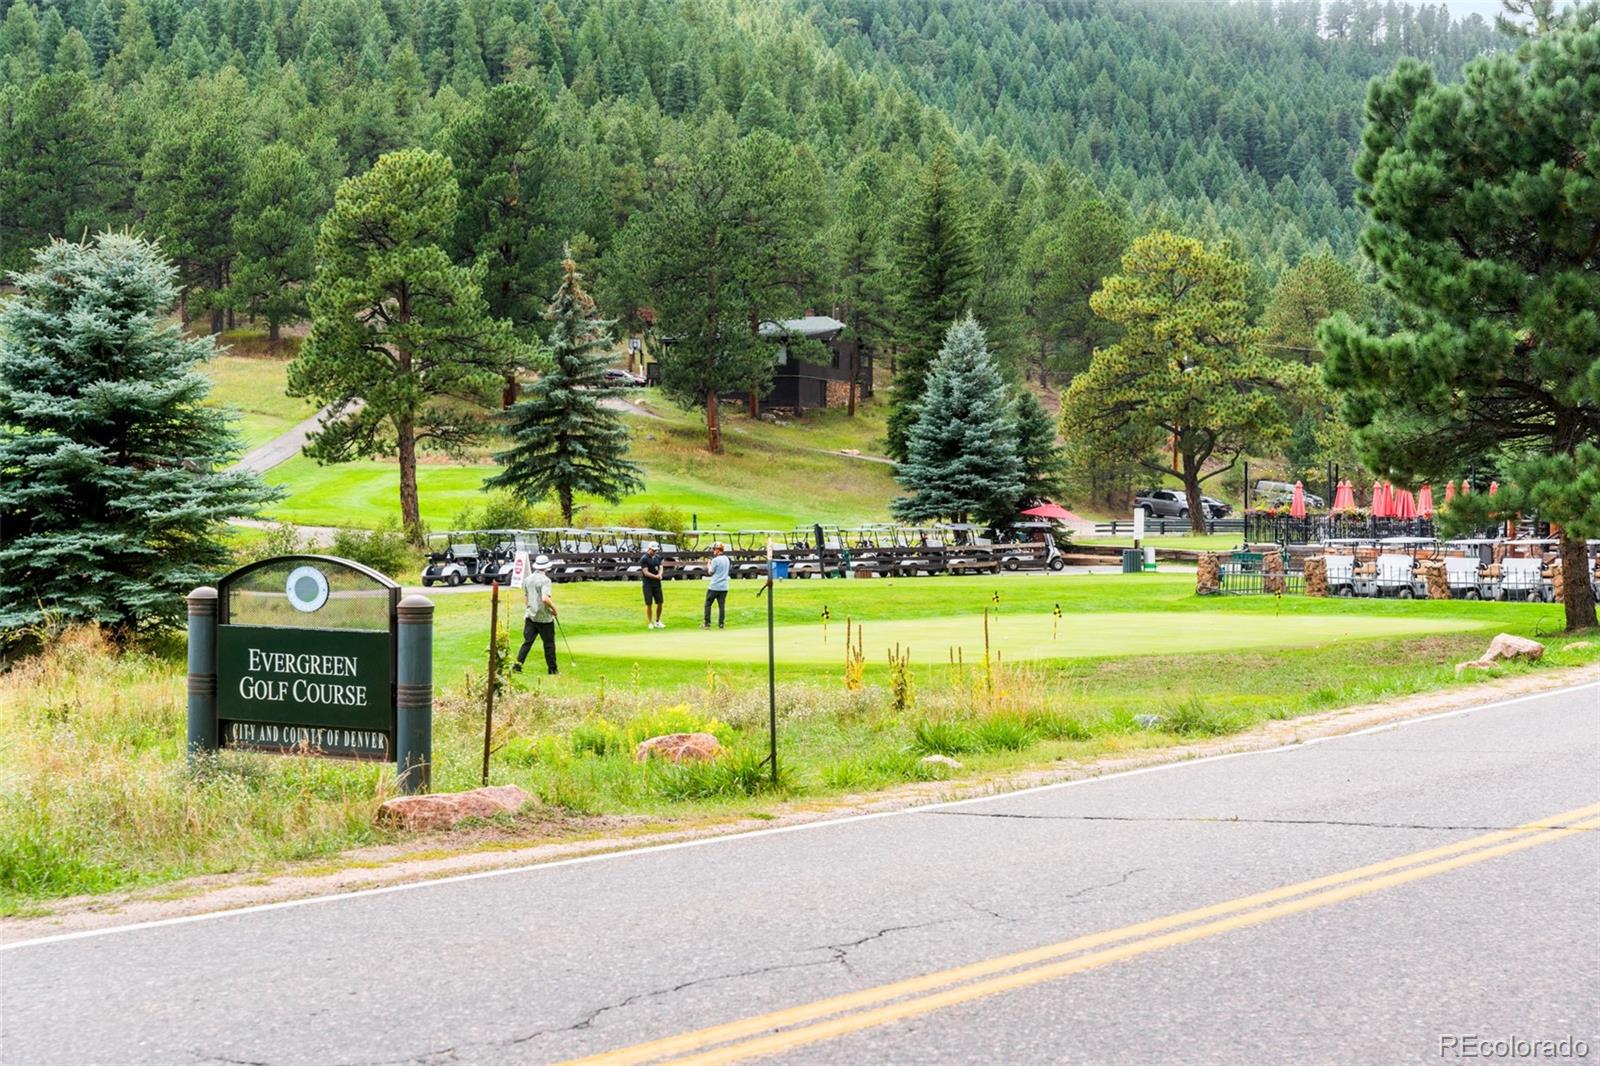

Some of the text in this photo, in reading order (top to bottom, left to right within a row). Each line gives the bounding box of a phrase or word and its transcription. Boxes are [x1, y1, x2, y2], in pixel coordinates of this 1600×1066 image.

[248, 648, 358, 677] EVERGREEN
[239, 676, 368, 706] GOLF COURSE
[232, 723, 256, 741] CITY
[259, 725, 279, 742] AND
[327, 730, 340, 746] OF
[344, 731, 385, 749] DENVER
